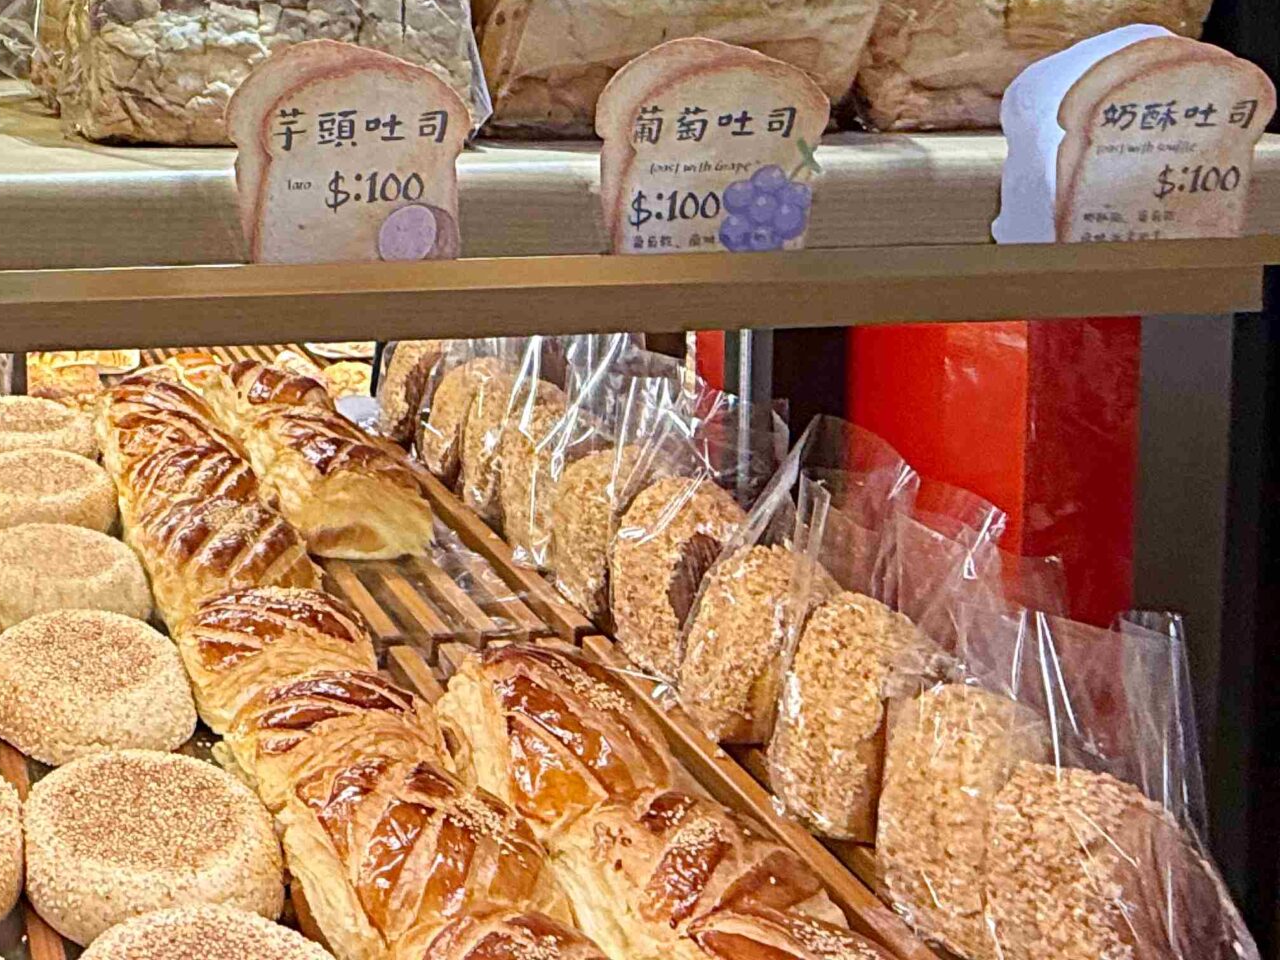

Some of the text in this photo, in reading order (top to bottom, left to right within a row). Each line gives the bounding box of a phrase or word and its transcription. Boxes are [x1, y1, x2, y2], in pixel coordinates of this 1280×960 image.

[274, 107, 449, 151] 芋頭吐司
[634, 105, 796, 145] 葡萄吐司
[1101, 99, 1258, 131] 奶酥吐司
[323, 170, 426, 214] $:100
[1153, 164, 1242, 200] $:100
[627, 189, 721, 231] $:100
